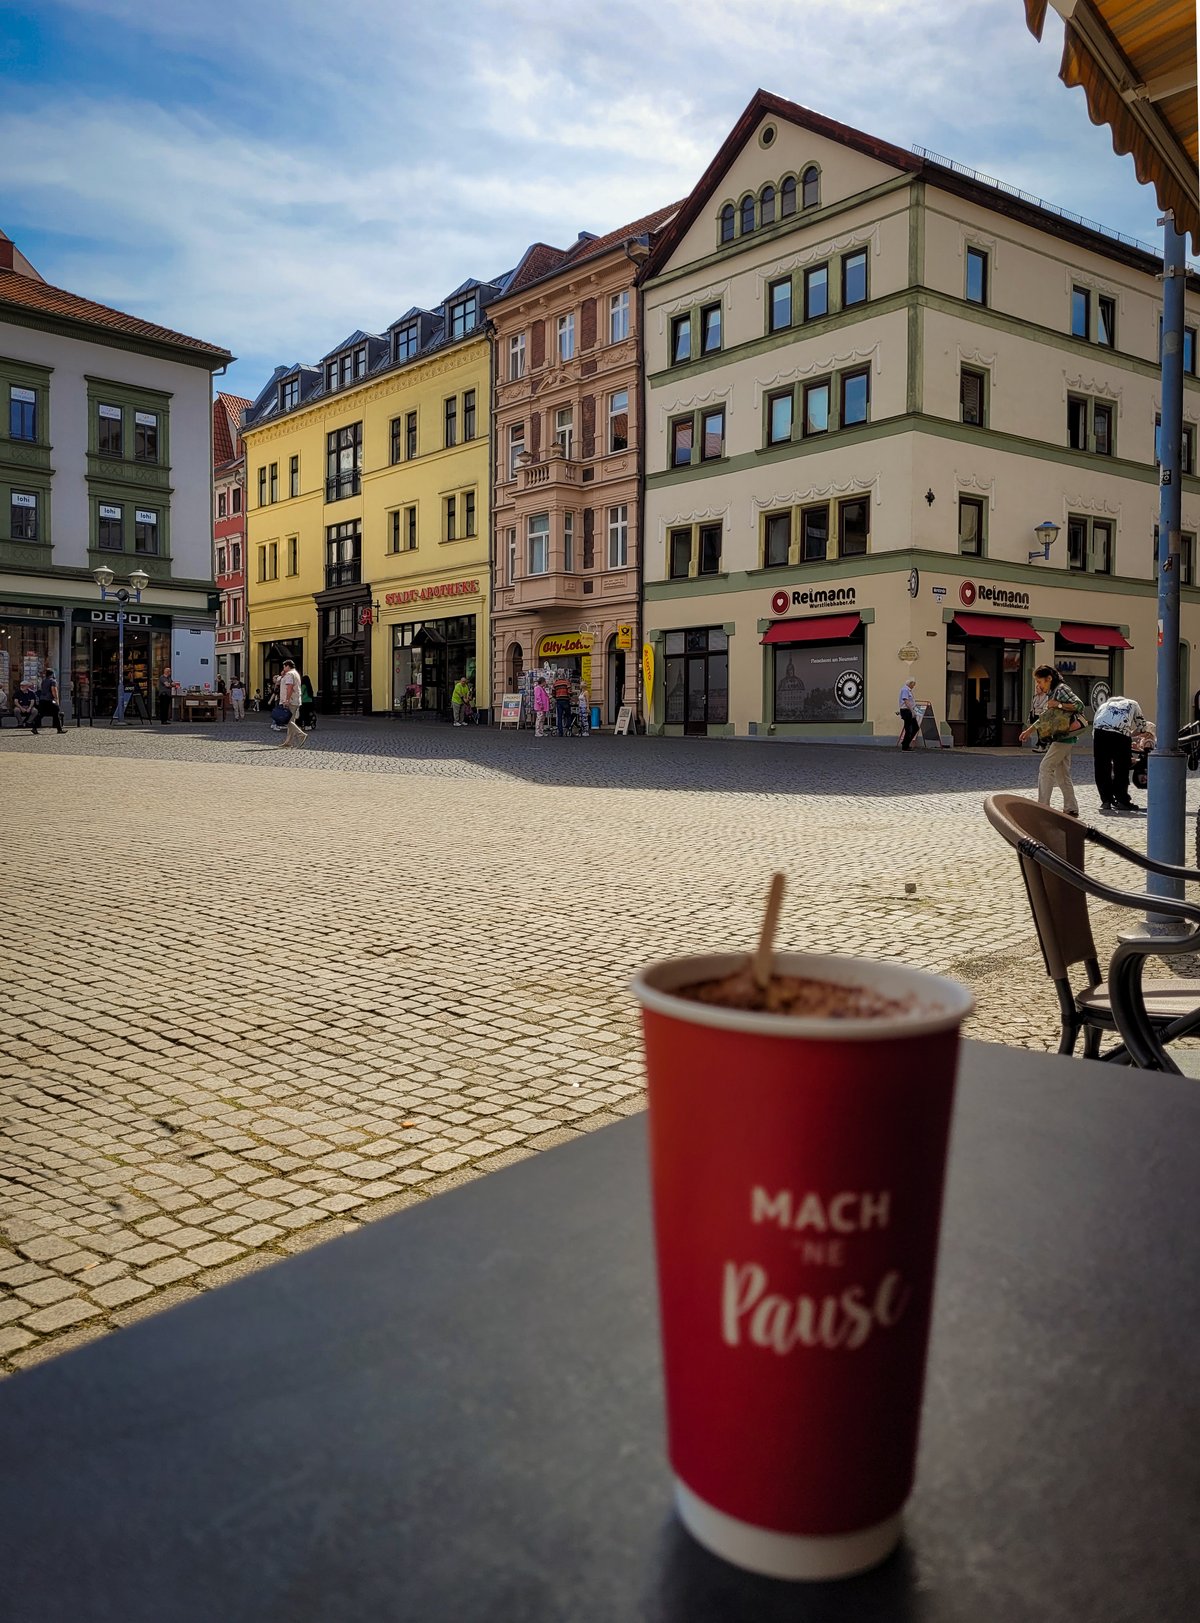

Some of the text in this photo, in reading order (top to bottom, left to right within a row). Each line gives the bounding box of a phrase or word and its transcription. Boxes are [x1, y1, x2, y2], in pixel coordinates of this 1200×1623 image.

[17, 495, 30, 503] lohi
[104, 507, 116, 515] lohi
[140, 512, 152, 520] lohi
[792, 587, 856, 605] Reimann
[978, 585, 1030, 605] Reimann
[809, 599, 856, 609] Wurstliebhaber.de
[751, 1185, 892, 1233] MACH
[721, 1258, 910, 1356] Pause
